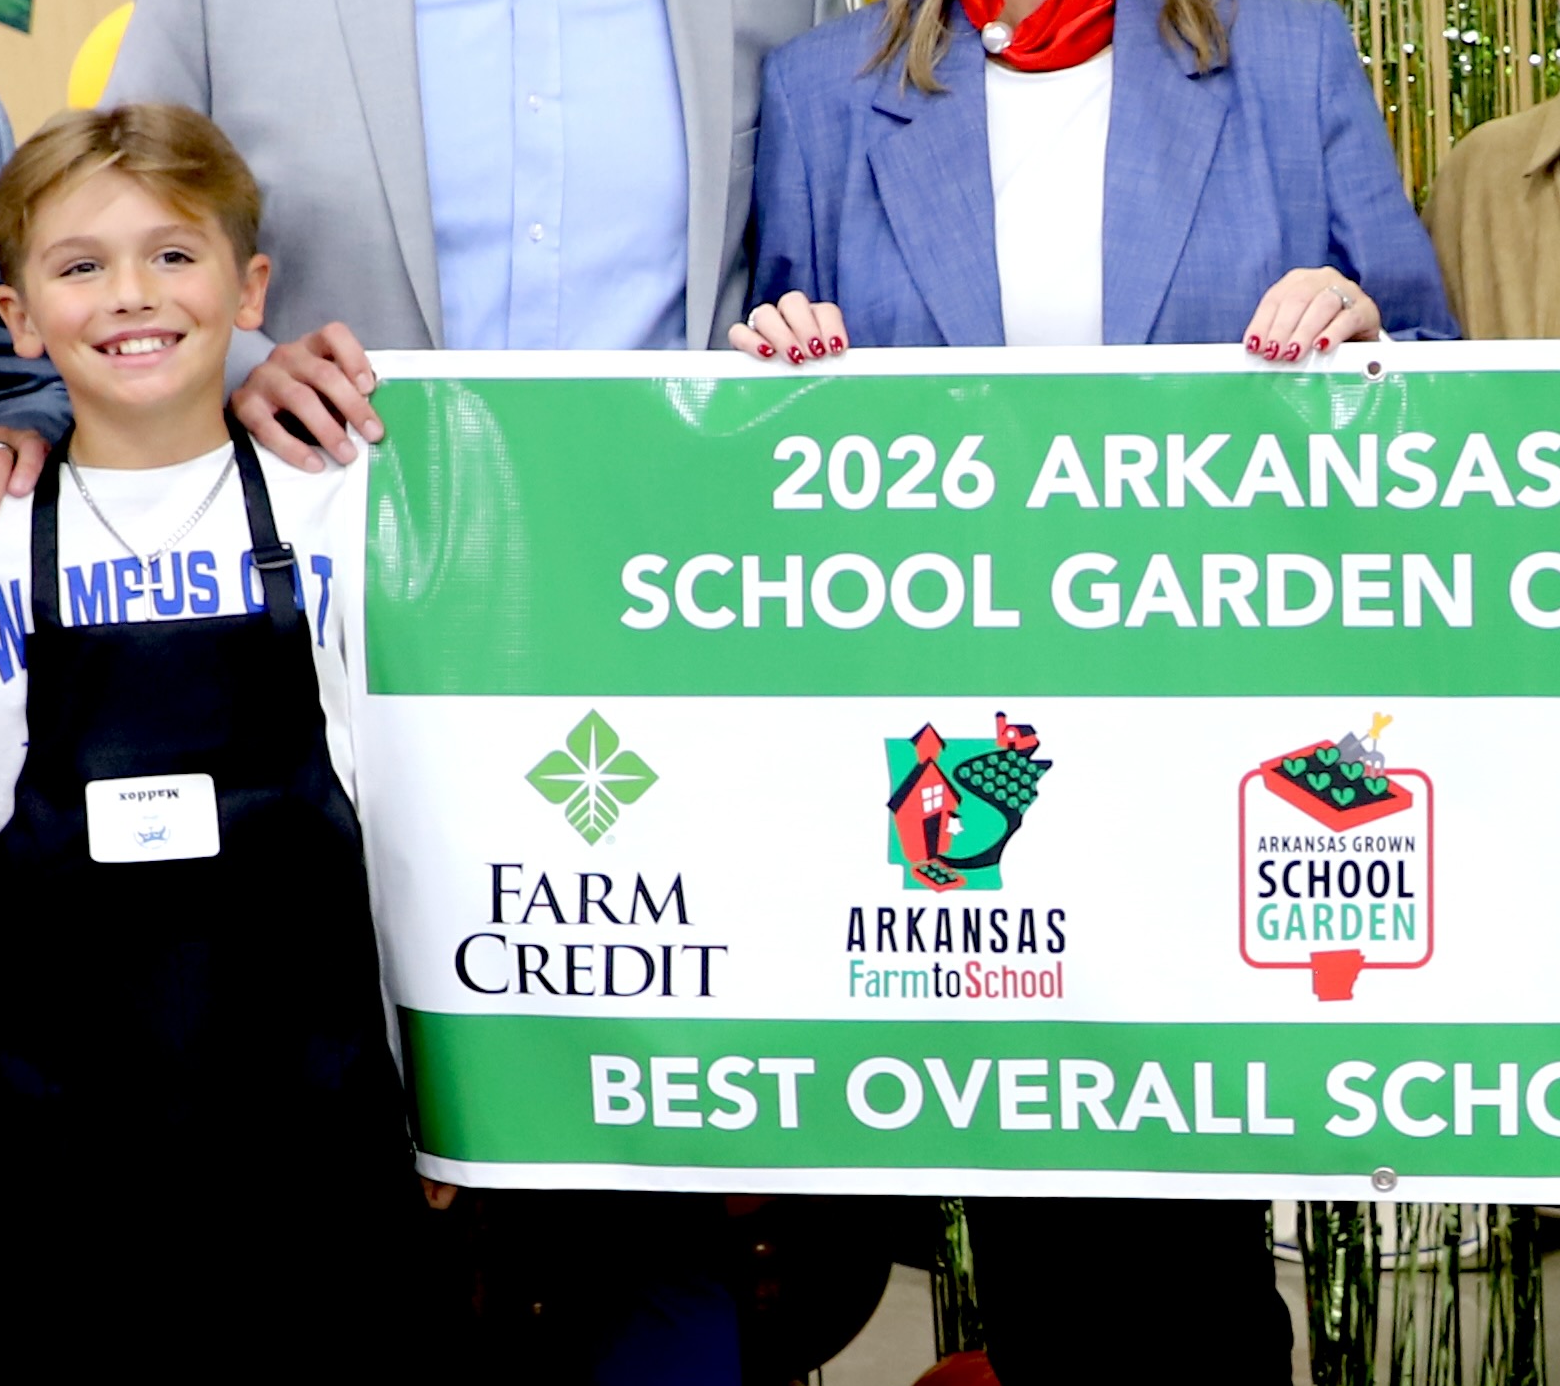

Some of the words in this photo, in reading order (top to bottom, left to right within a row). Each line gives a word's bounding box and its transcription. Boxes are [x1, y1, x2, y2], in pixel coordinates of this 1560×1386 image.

[771, 434, 997, 511] 2026
[241, 550, 333, 648] CT
[620, 552, 1021, 631] SCHOOL
[1050, 552, 1474, 629] GARDEN
[119, 787, 180, 802] Maddox
[1257, 835, 1347, 853] ARKANSAS
[1352, 835, 1416, 853] GROWN
[485, 862, 695, 926] FARM
[1257, 859, 1415, 899] SCHOOL
[846, 907, 1066, 954] ARKANSAS
[1256, 902, 1416, 941] GARDEN
[454, 932, 728, 998] CREDIT
[589, 1054, 815, 1129] BEST
[845, 1056, 1295, 1135] OVERALL
